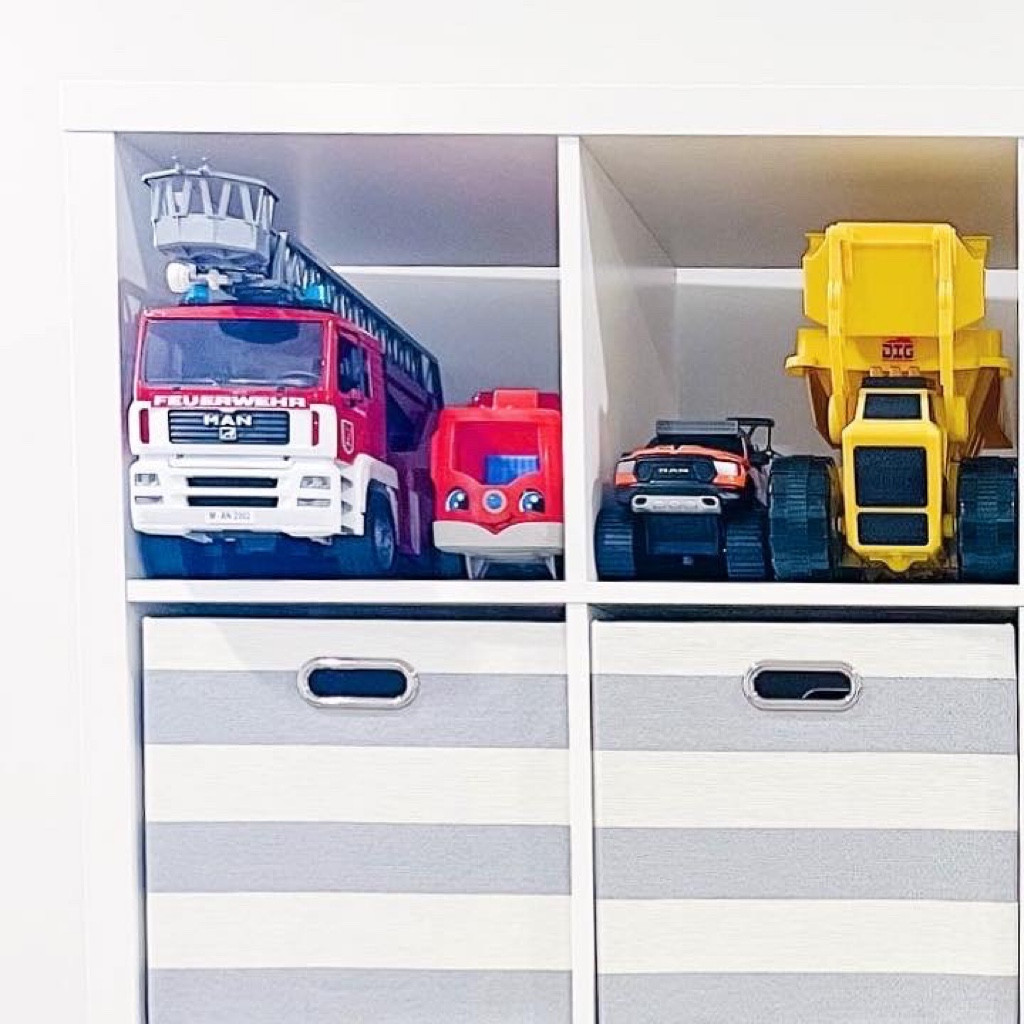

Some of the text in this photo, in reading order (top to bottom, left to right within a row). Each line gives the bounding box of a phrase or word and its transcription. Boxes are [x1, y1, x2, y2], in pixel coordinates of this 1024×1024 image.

[882, 343, 914, 359] DIG
[153, 394, 307, 408] FEUERWEHR
[203, 413, 253, 426] MAN
